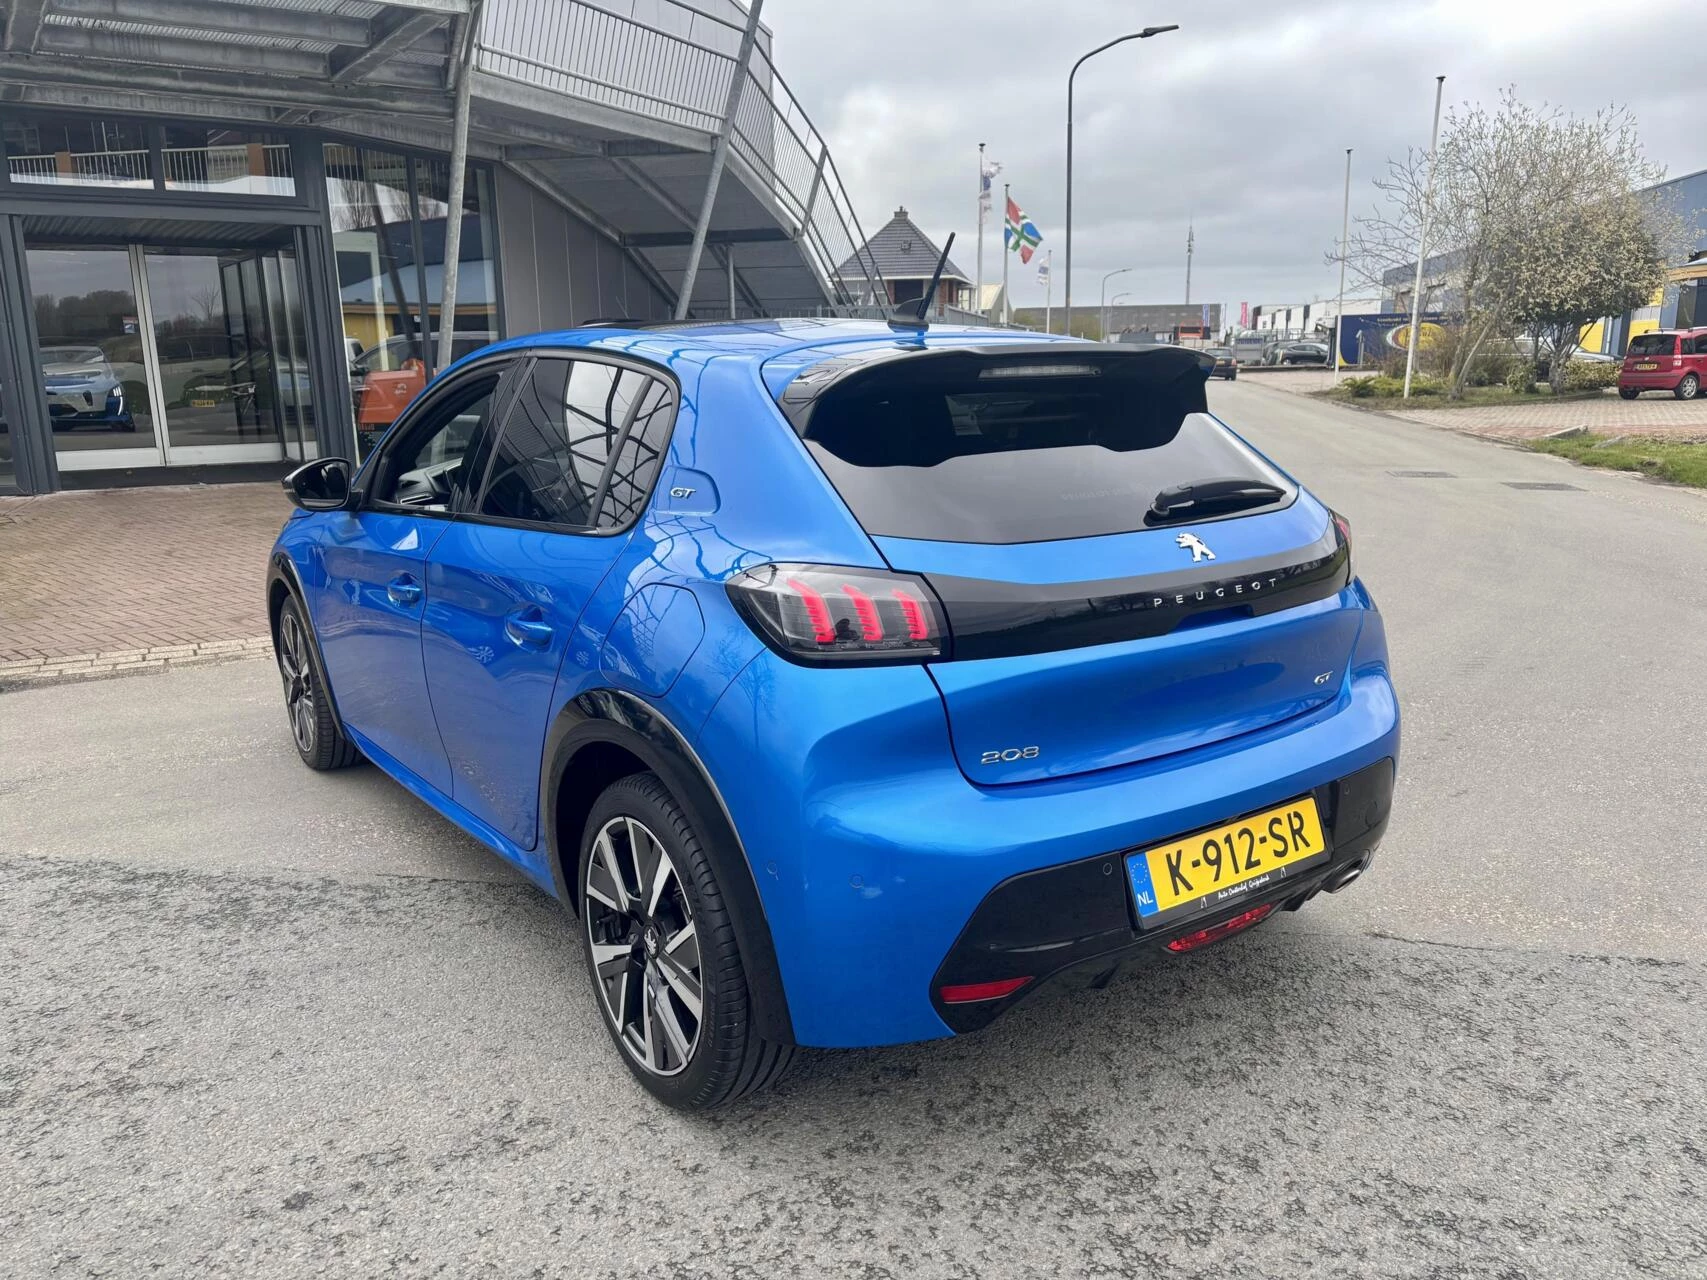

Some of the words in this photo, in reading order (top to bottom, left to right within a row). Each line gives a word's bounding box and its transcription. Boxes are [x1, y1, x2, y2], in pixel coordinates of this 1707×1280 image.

[670, 487, 697, 499] GT
[1153, 578, 1277, 608] PEUGEOT
[1313, 670, 1334, 686] GT
[981, 746, 1040, 764] 208
[1165, 810, 1311, 896] K-912-SR
[1137, 892, 1154, 907] NL
